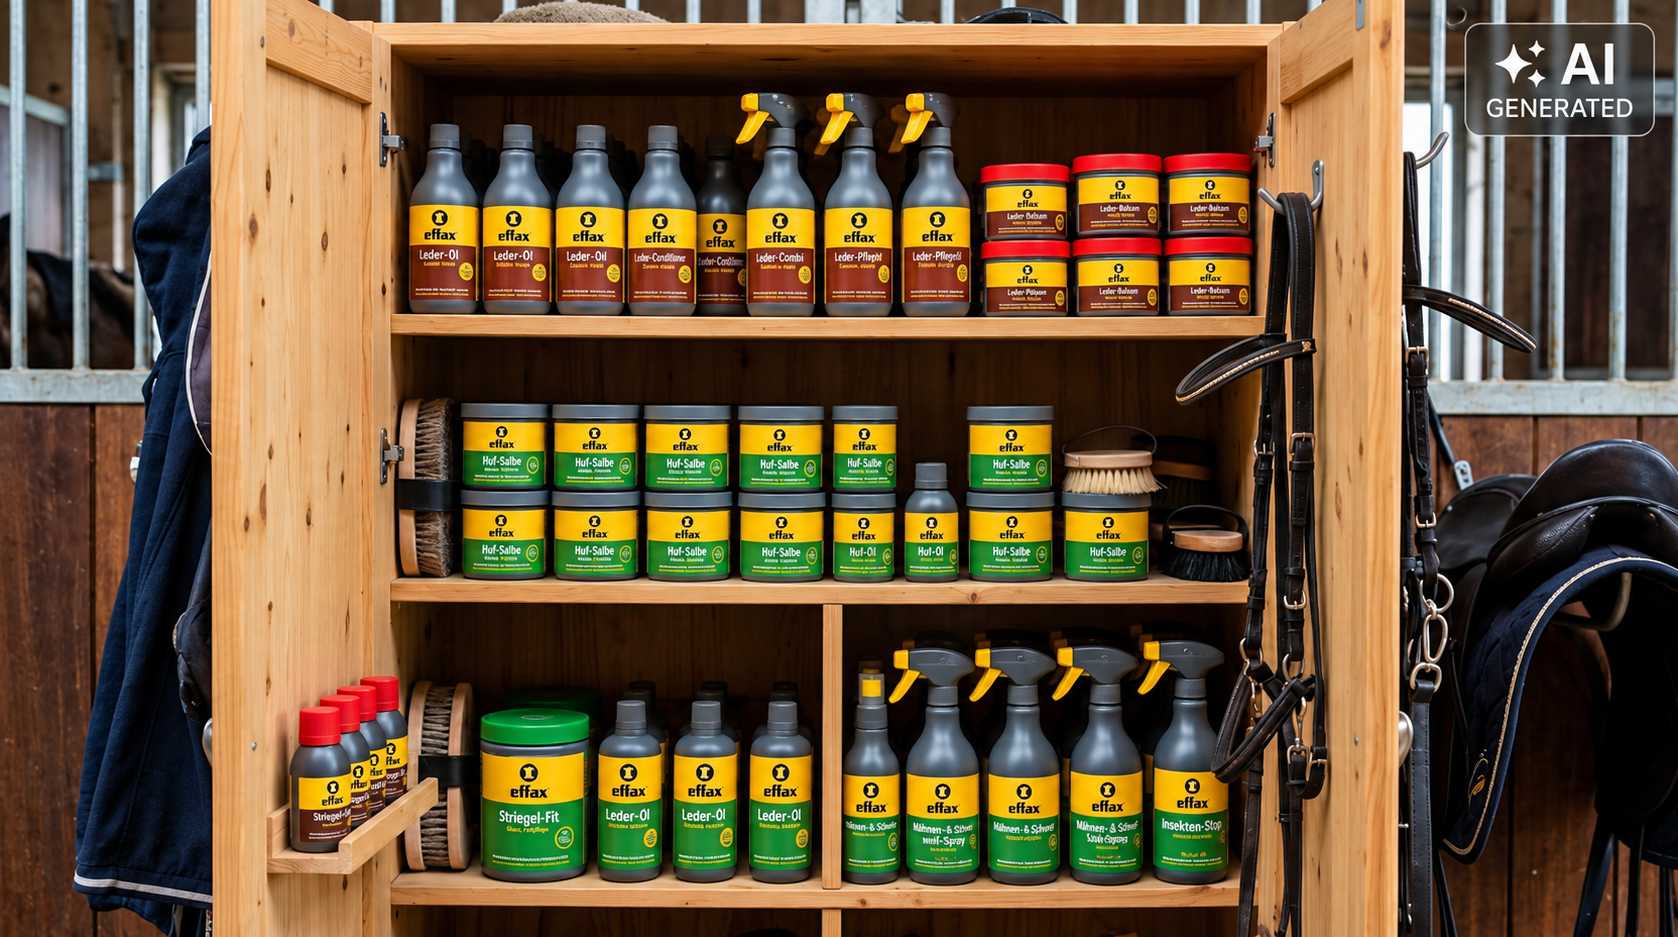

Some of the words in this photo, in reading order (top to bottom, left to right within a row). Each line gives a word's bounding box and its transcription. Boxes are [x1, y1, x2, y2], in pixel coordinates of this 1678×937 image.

[1109, 191, 1131, 201] effax
[1199, 191, 1221, 201] effax
[1017, 200, 1039, 210] effax
[424, 228, 456, 241] effax
[498, 230, 530, 242] effax
[572, 230, 605, 243] effax
[644, 232, 676, 244] effax
[764, 232, 796, 244] effax
[843, 231, 875, 244] effax
[921, 230, 953, 242] effax
[705, 236, 736, 249] effax
[1016, 276, 1039, 286] effax
[1108, 273, 1130, 284] effax
[1199, 273, 1221, 283] effax
[488, 439, 515, 450] effax
[582, 441, 608, 452] effax
[672, 442, 699, 452] effax
[767, 442, 792, 453] effax
[852, 441, 877, 452] effax
[999, 443, 1024, 453] effax
[482, 456, 521, 466] Huf-Salbe
[575, 458, 614, 468] Huf-Salbe
[666, 459, 705, 469] Huf-Salbe
[760, 460, 799, 470] Huf-Salbe
[847, 458, 881, 468] Huf-Salbe
[992, 460, 1030, 470] Huf-Salbe
[488, 528, 514, 539] effax
[581, 529, 608, 540] effax
[674, 530, 701, 540] effax
[768, 530, 794, 541] effax
[851, 531, 876, 542] effax
[919, 530, 944, 541] effax
[999, 530, 1025, 541] effax
[1096, 530, 1121, 541] effax
[481, 545, 521, 555] Huf-Salbe
[574, 546, 614, 556] Huf-Salbe
[667, 547, 707, 557] Huf-Salbe
[761, 548, 800, 558] Huf-Salbe
[992, 547, 1031, 557] Huf-Salbe
[1089, 547, 1126, 557] Huf-Salbe
[510, 785, 548, 799] effax
[611, 784, 646, 798] effax
[687, 784, 722, 798] effax
[763, 784, 798, 798] effax
[855, 801, 887, 813] effax
[926, 802, 959, 814] effax
[1008, 802, 1040, 814] effax
[1091, 800, 1124, 813] effax
[1176, 796, 1209, 809] effax
[499, 810, 559, 827] Striegel-Fit
[1161, 818, 1221, 832] Insekten-Stop
